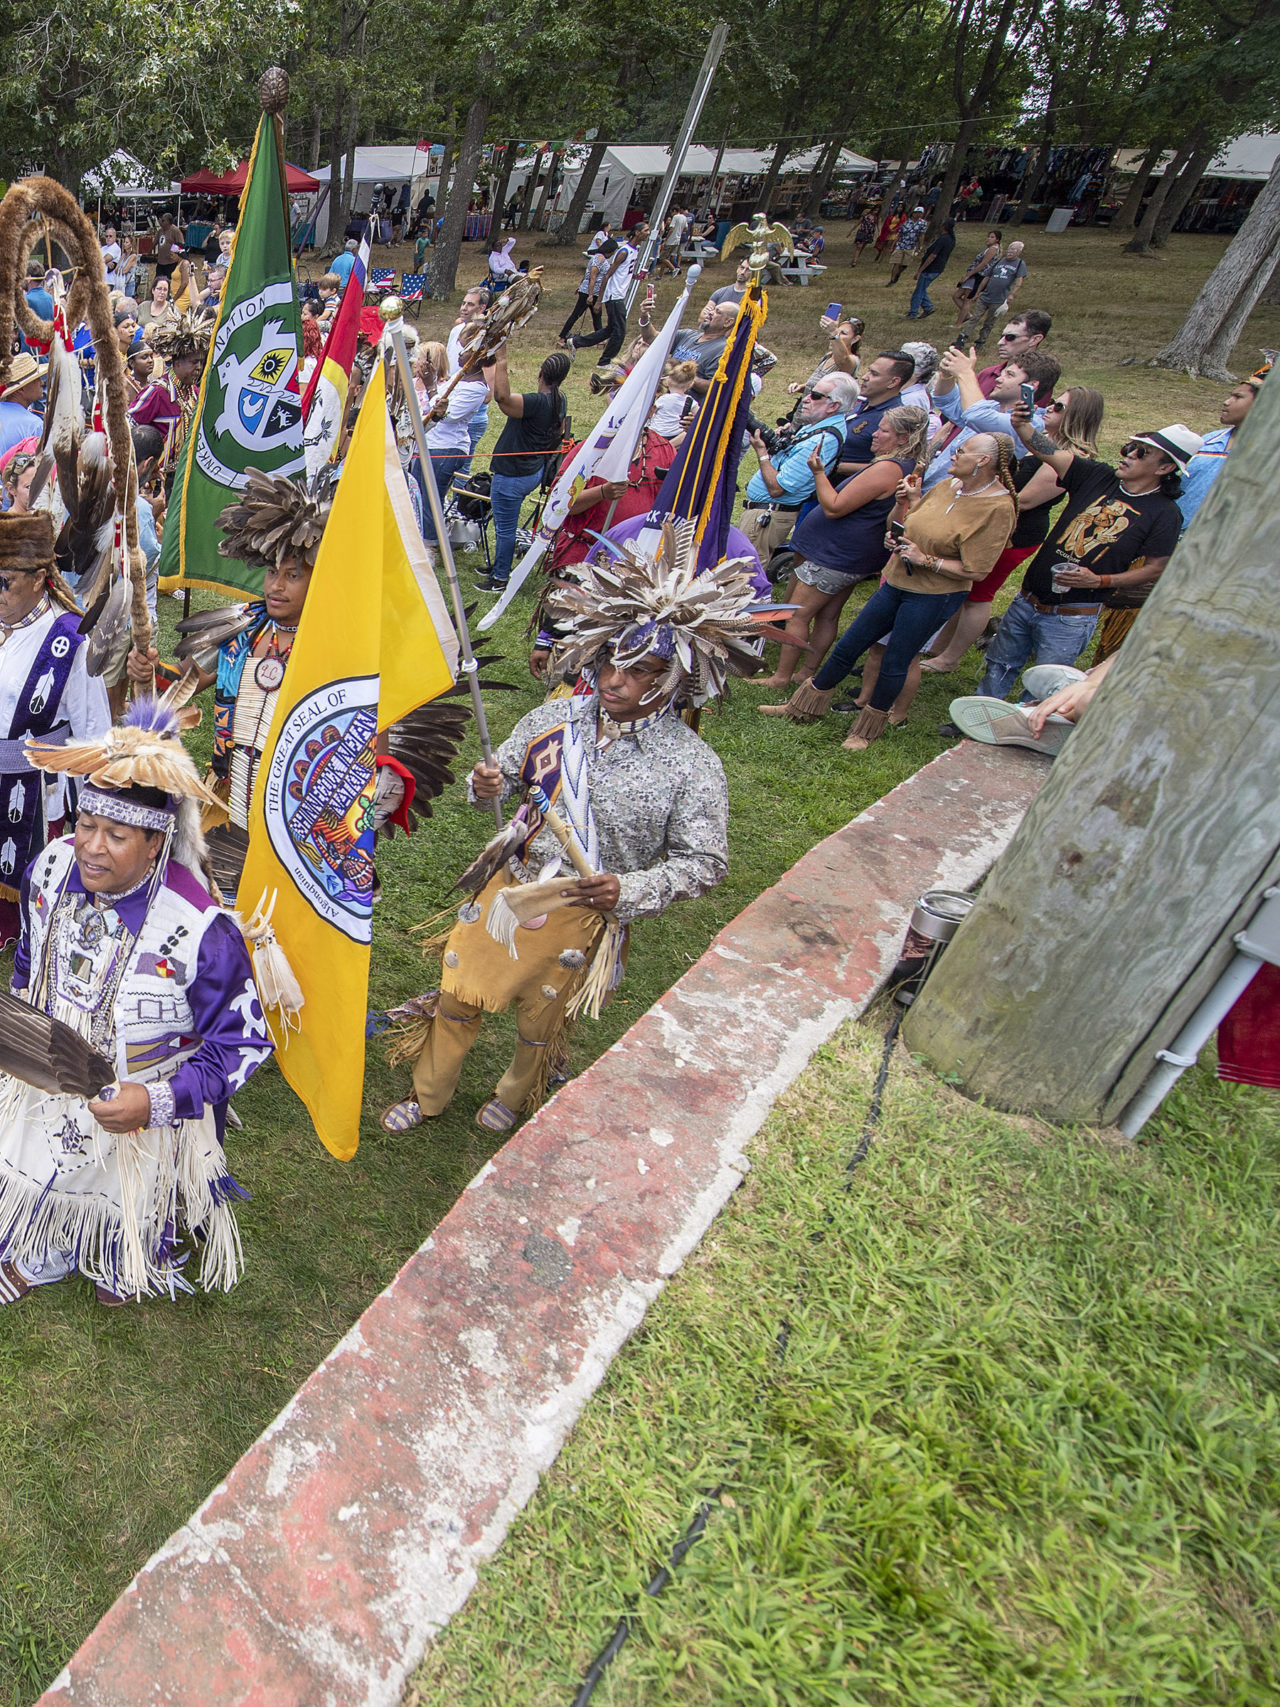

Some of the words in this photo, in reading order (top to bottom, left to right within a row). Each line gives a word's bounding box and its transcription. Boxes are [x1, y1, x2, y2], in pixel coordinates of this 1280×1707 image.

[215, 293, 266, 351] NATION
[292, 701, 328, 733] SEAL
[327, 689, 347, 707] OF
[272, 727, 295, 779] GREAT
[269, 781, 280, 815] THE
[294, 867, 340, 918] Algonquian
